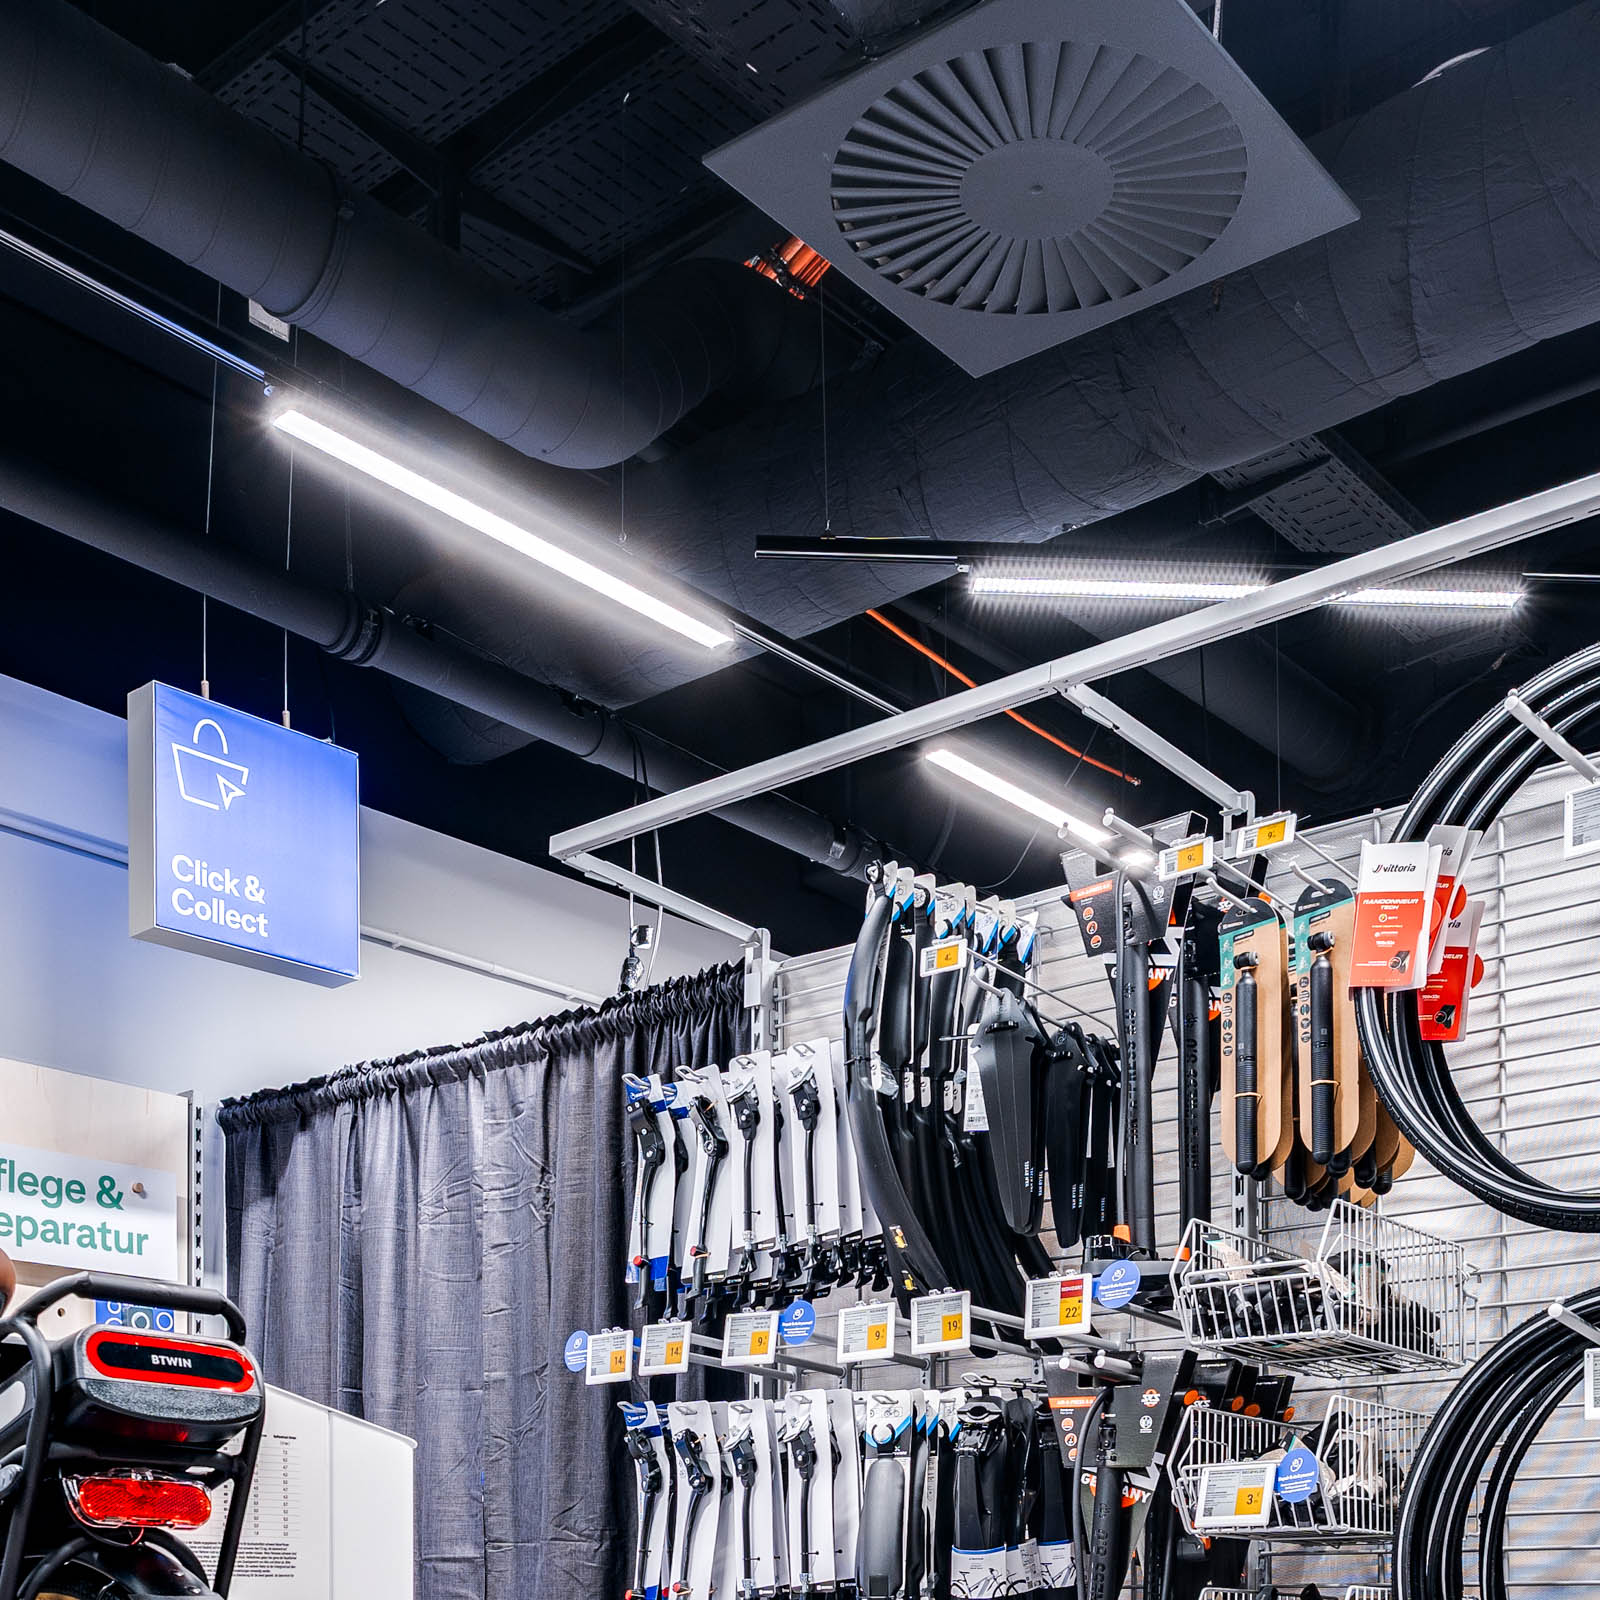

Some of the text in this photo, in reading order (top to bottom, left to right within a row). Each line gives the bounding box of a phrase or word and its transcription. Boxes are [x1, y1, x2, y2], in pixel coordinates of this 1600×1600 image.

[172, 854, 265, 905] Click &
[1382, 863, 1416, 873] vittoria
[172, 888, 268, 937] Collect
[95, 1174, 124, 1211] &
[150, 1354, 192, 1369] BTWIN
[1081, 1473, 1151, 1503] GEANY
